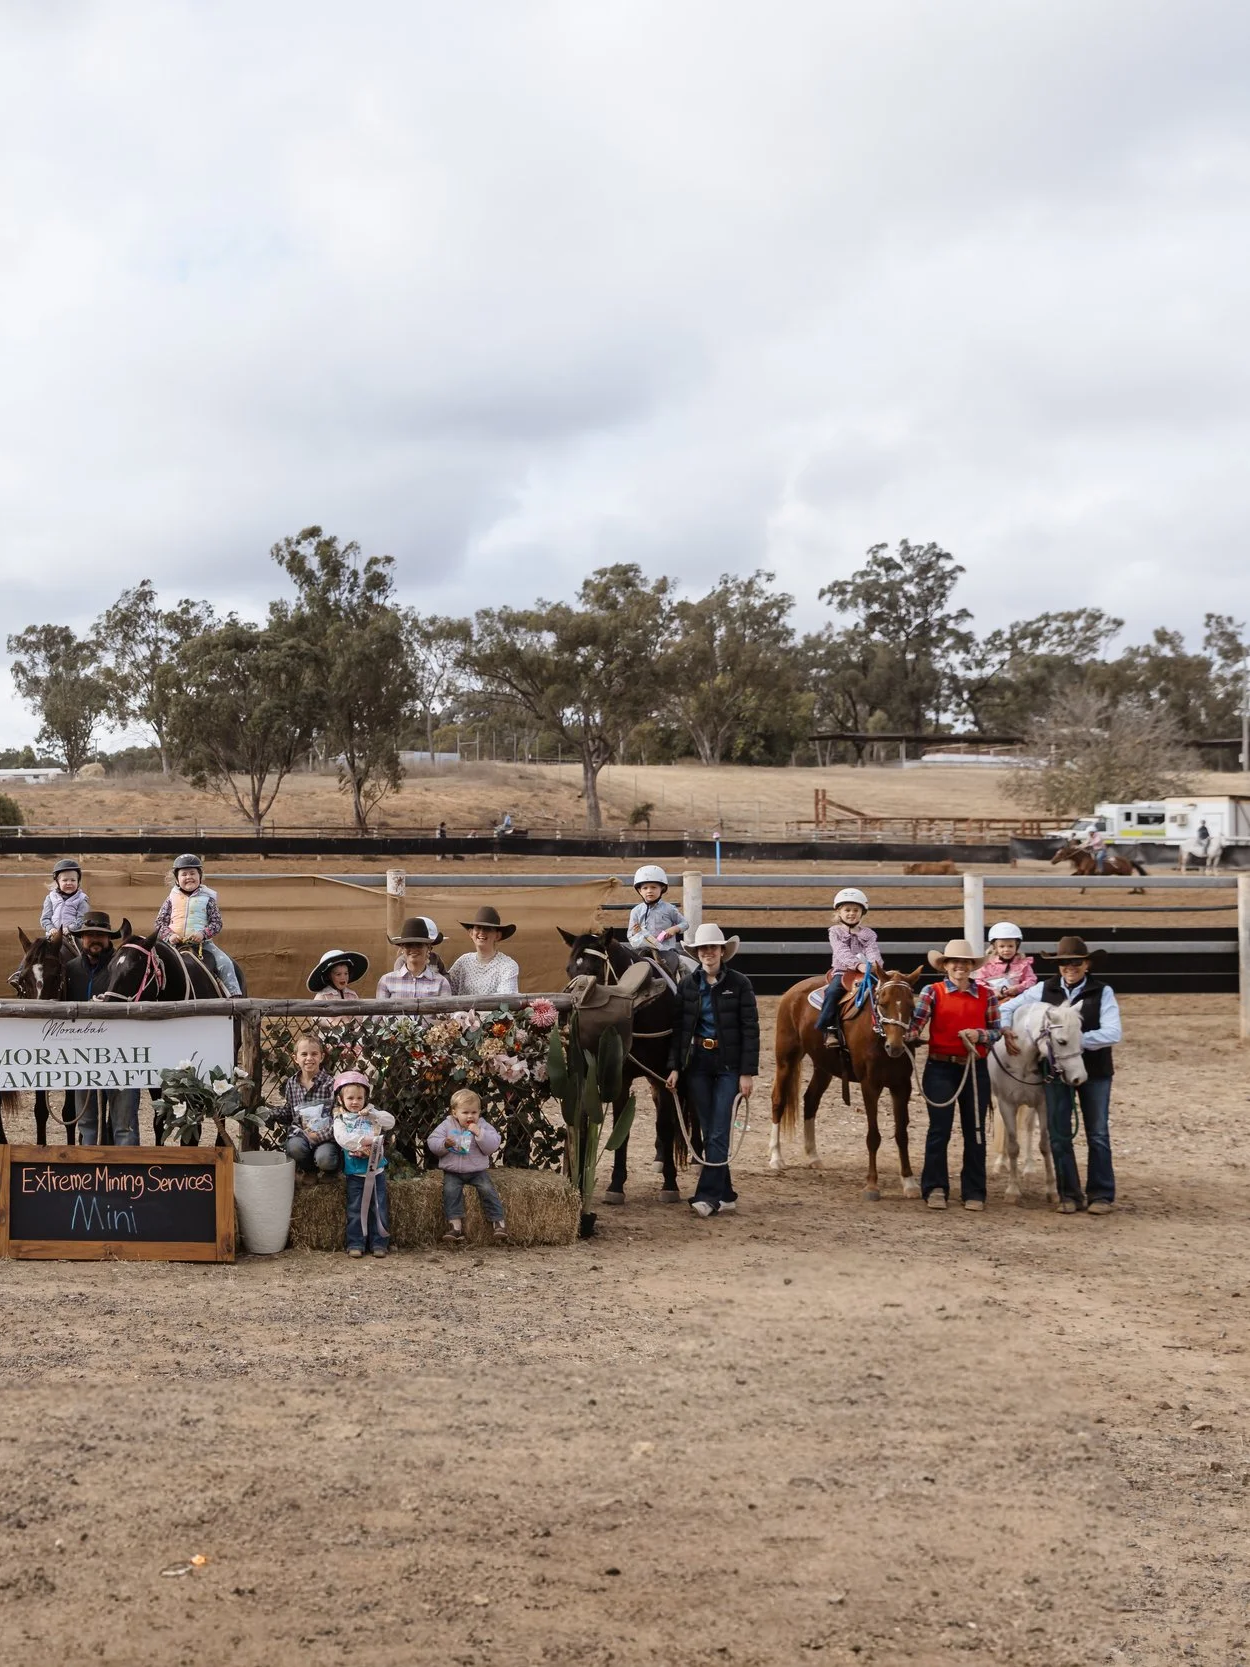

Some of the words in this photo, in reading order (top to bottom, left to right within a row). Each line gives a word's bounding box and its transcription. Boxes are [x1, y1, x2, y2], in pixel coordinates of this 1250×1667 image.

[42, 1019, 108, 1041] Moranbah
[22, 1166, 92, 1193] Extreme
[95, 1165, 145, 1200] Mining
[147, 1165, 214, 1192] Services
[71, 1195, 138, 1234] Mini
